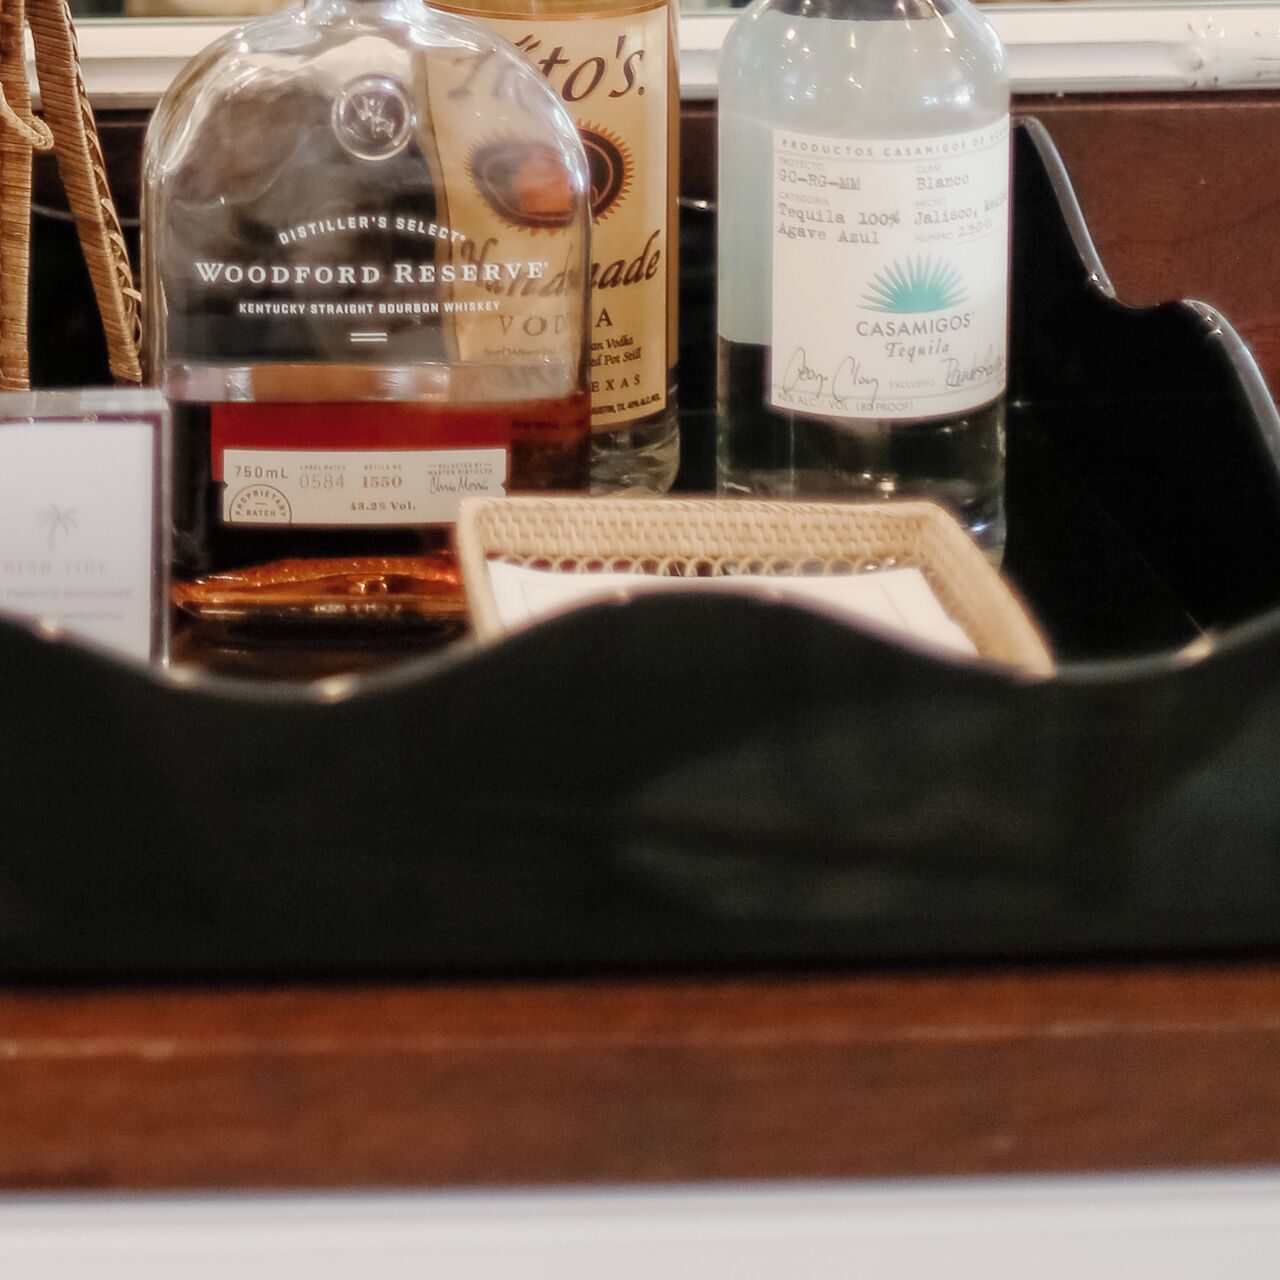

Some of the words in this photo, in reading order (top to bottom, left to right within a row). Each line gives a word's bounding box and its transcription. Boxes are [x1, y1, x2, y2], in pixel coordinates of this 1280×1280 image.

[781, 138, 874, 157] PRODUCTOS
[883, 141, 966, 157] CASAMIGOS
[916, 174, 970, 190] Blanco
[778, 202, 845, 224] Tequila
[859, 209, 902, 229] 100%
[914, 207, 978, 226] Jalisco,
[278, 216, 388, 245] DISTILLER'S
[395, 217, 461, 242] SELECT
[778, 222, 827, 241] Agave
[838, 230, 880, 244] Azul
[195, 262, 381, 285] WOODFORD
[394, 260, 546, 284] RESERVE
[239, 302, 306, 315] KENTUCKY
[310, 303, 374, 315] STRAIGHT
[378, 302, 439, 314] BOURBON
[443, 301, 501, 313] WHISKEY
[856, 313, 971, 338] CASAMIGOS
[885, 338, 951, 363] Tequila
[591, 374, 641, 393] EXAS
[234, 465, 289, 479] 750mL
[300, 473, 345, 490] 0584
[363, 475, 403, 489] 1550
[235, 490, 287, 517] PROPRIETARY
[246, 509, 277, 517] BATCH
[390, 501, 417, 511] Vol.
